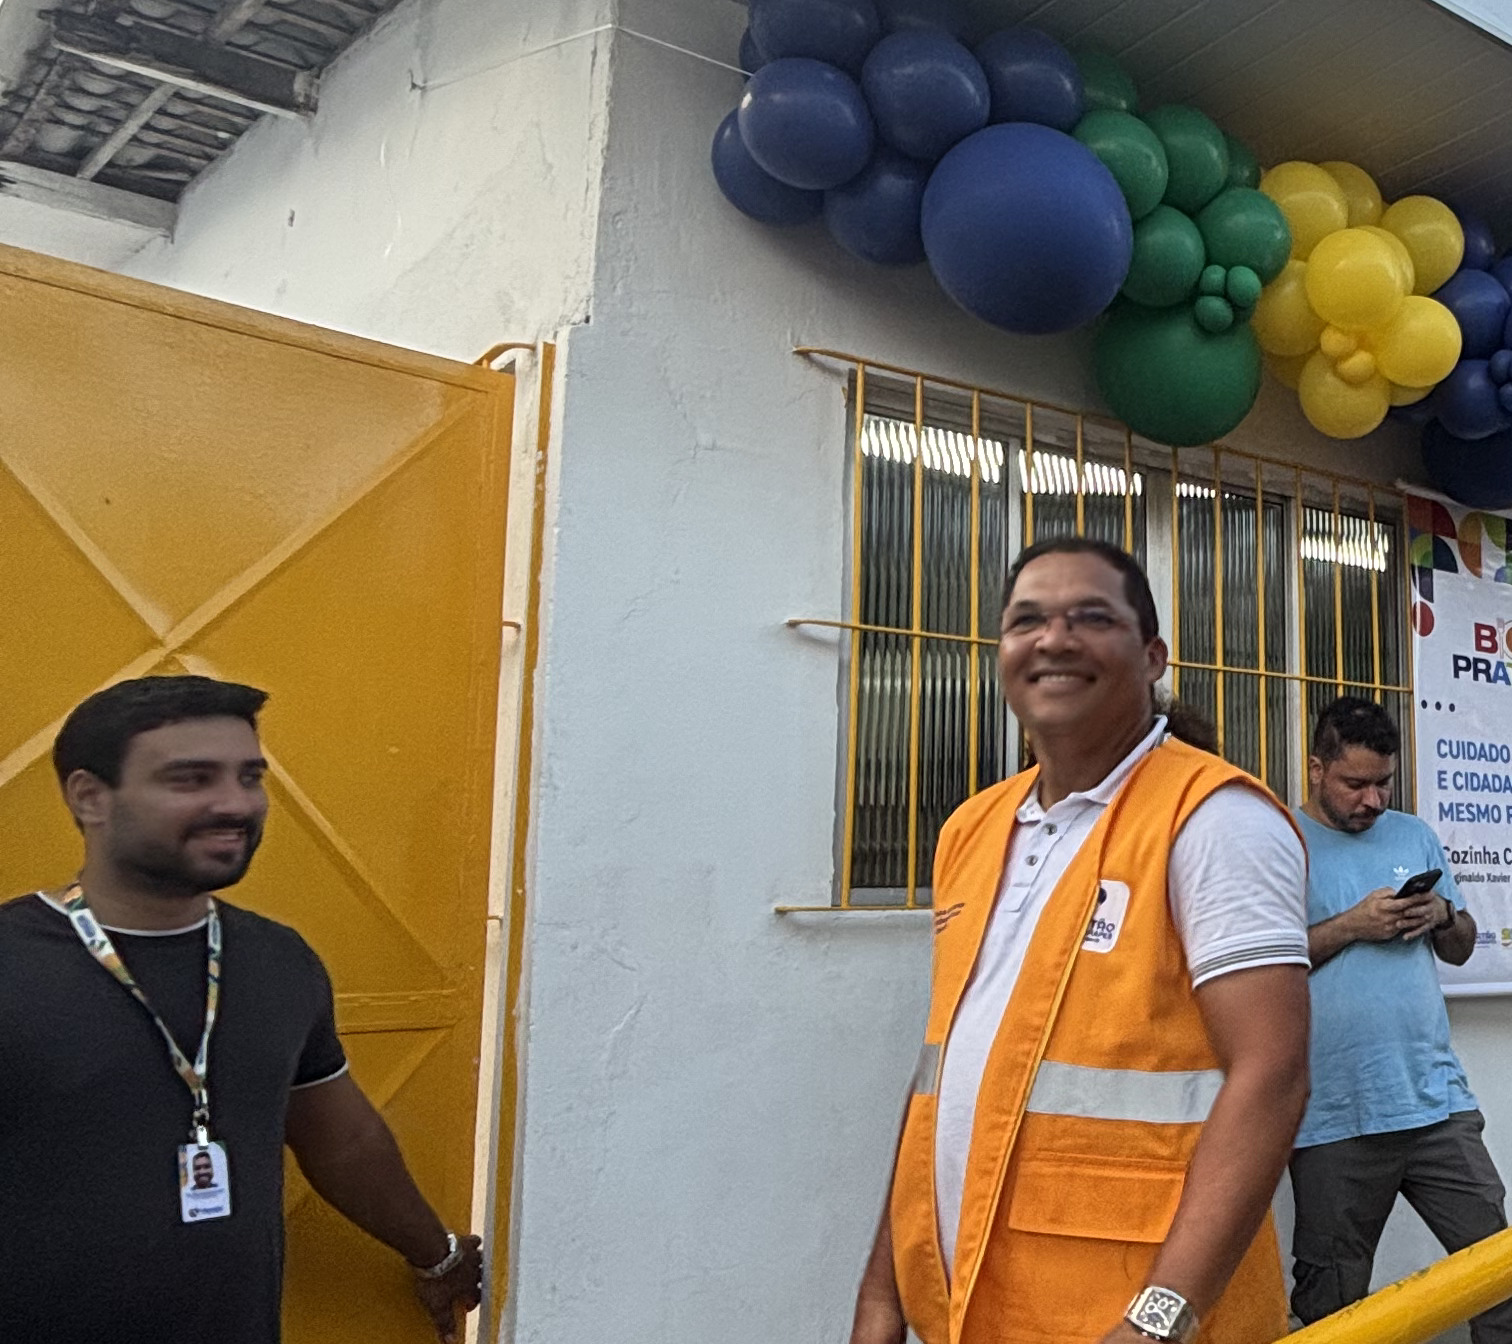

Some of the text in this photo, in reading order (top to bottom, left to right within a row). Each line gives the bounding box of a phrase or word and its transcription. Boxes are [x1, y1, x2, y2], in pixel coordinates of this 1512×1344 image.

[1436, 738, 1511, 764] CUIDADO
[1437, 770, 1449, 790] E
[1438, 801, 1502, 824] MESMO
[1486, 872, 1511, 884] Xavier
